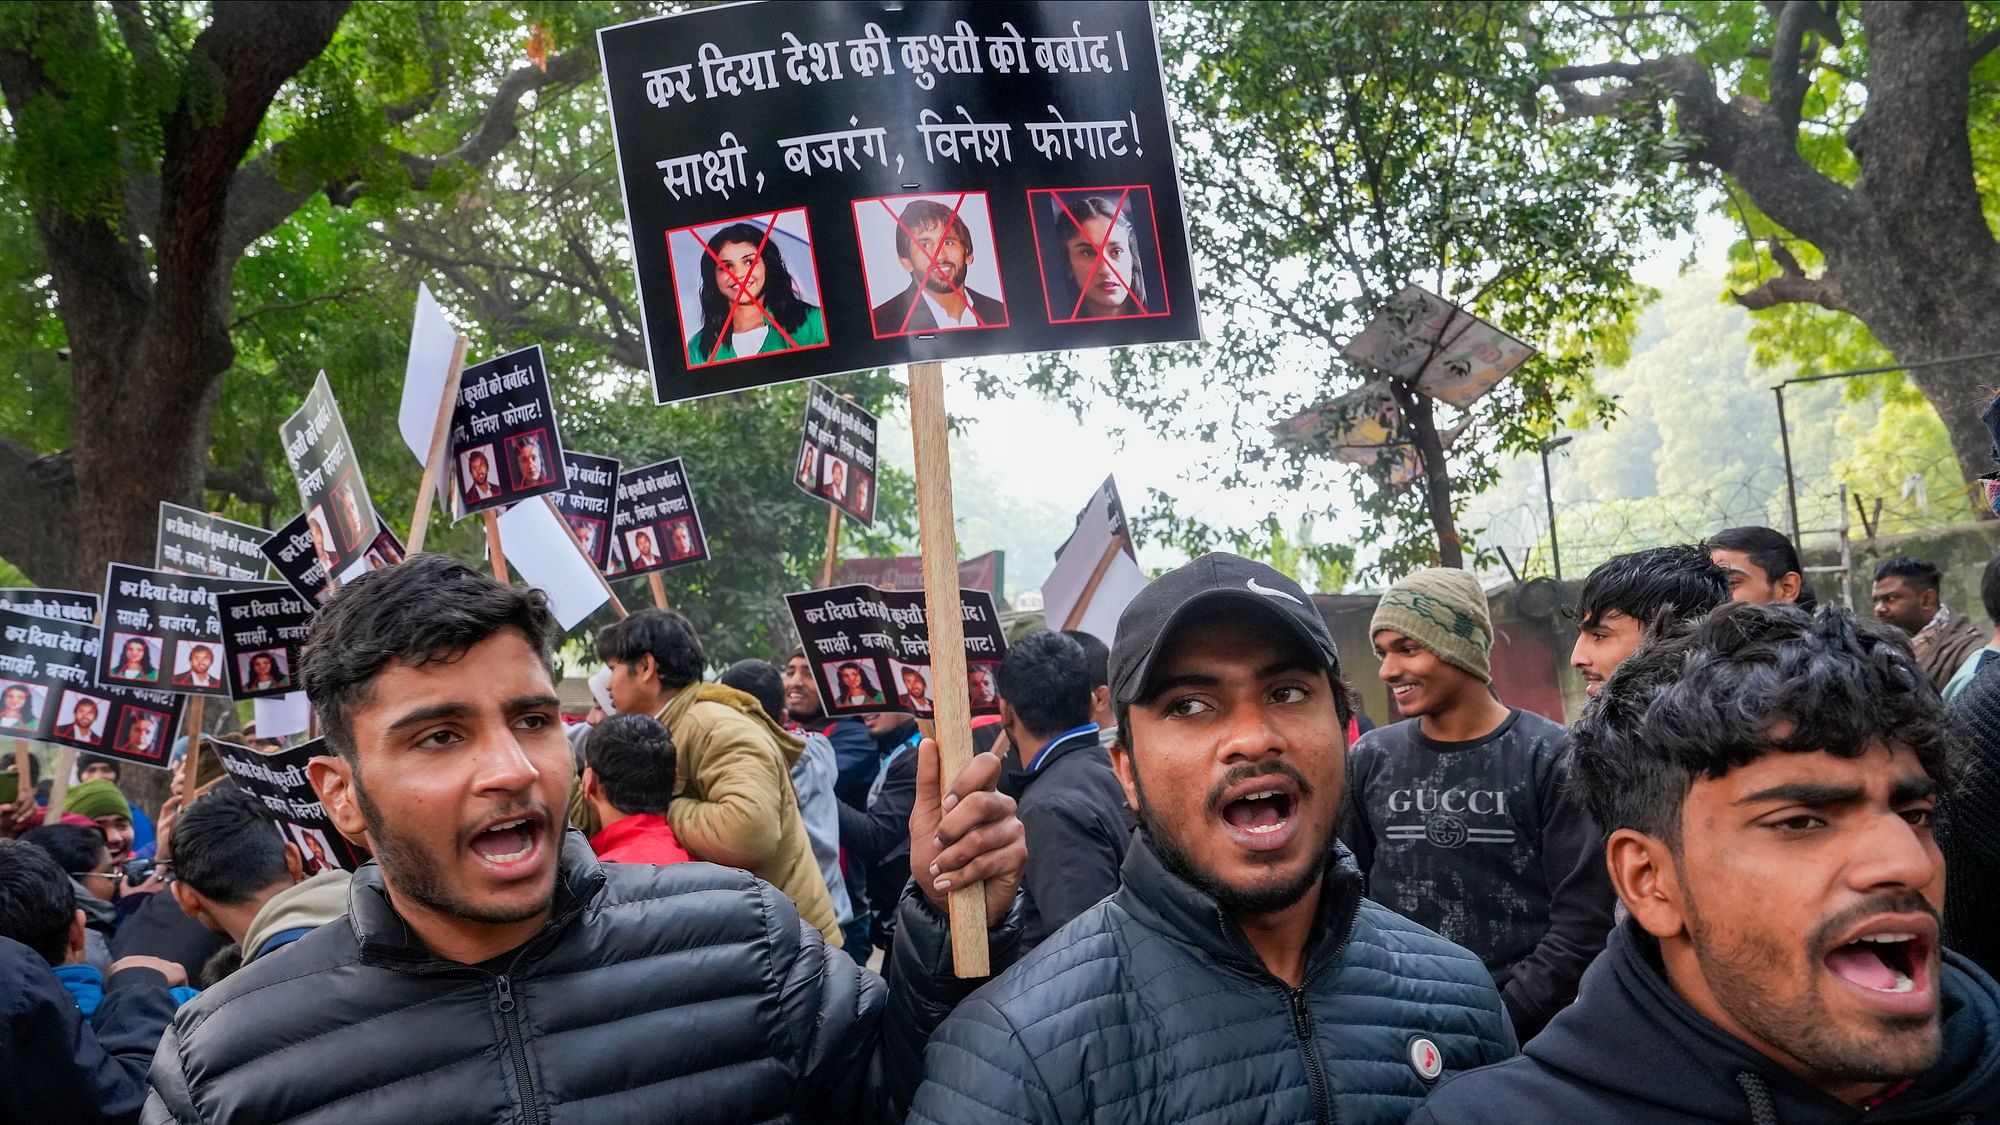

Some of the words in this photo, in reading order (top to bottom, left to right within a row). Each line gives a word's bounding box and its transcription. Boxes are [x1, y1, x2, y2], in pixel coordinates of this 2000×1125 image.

[643, 63, 696, 109] कर
[698, 42, 780, 98] दिया
[782, 31, 844, 86] देश
[846, 22, 895, 77] की
[897, 20, 984, 91] कुश्ती
[985, 22, 1030, 74] को
[916, 105, 1012, 168] विनेश
[1024, 104, 1143, 159] फोगाट!
[471, 411, 500, 437] विनेश
[569, 489, 609, 514] फोगाट!
[278, 543, 300, 562] कर
[230, 604, 250, 619] कर
[804, 607, 828, 623] कर
[824, 600, 858, 621] दिया
[856, 597, 880, 617] देश
[889, 603, 924, 630] कुश्ती
[1389, 789, 1505, 815] GUCCI
